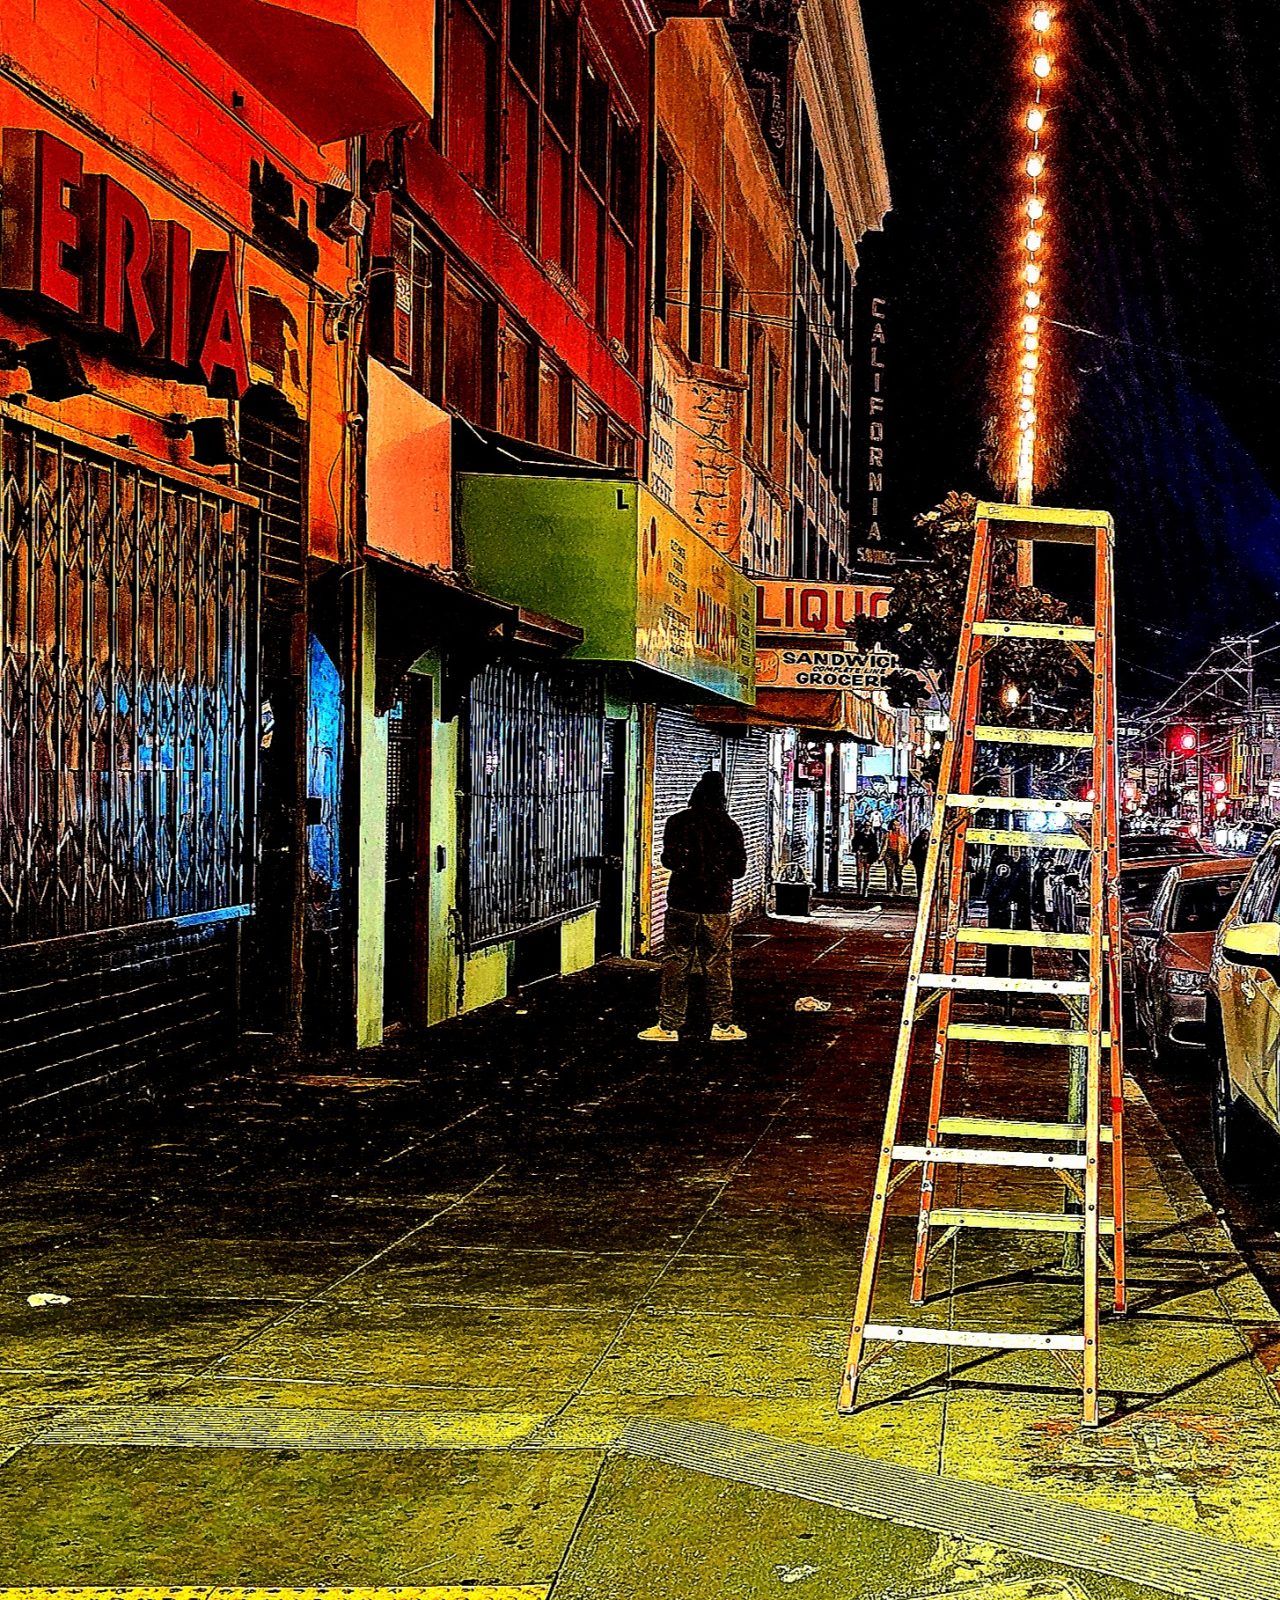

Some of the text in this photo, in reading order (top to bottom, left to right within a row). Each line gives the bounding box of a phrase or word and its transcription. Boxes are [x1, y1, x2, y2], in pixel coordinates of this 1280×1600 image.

[868, 297, 886, 541] CALIFORNIA
[812, 665, 886, 675] COMPLETE LINE
